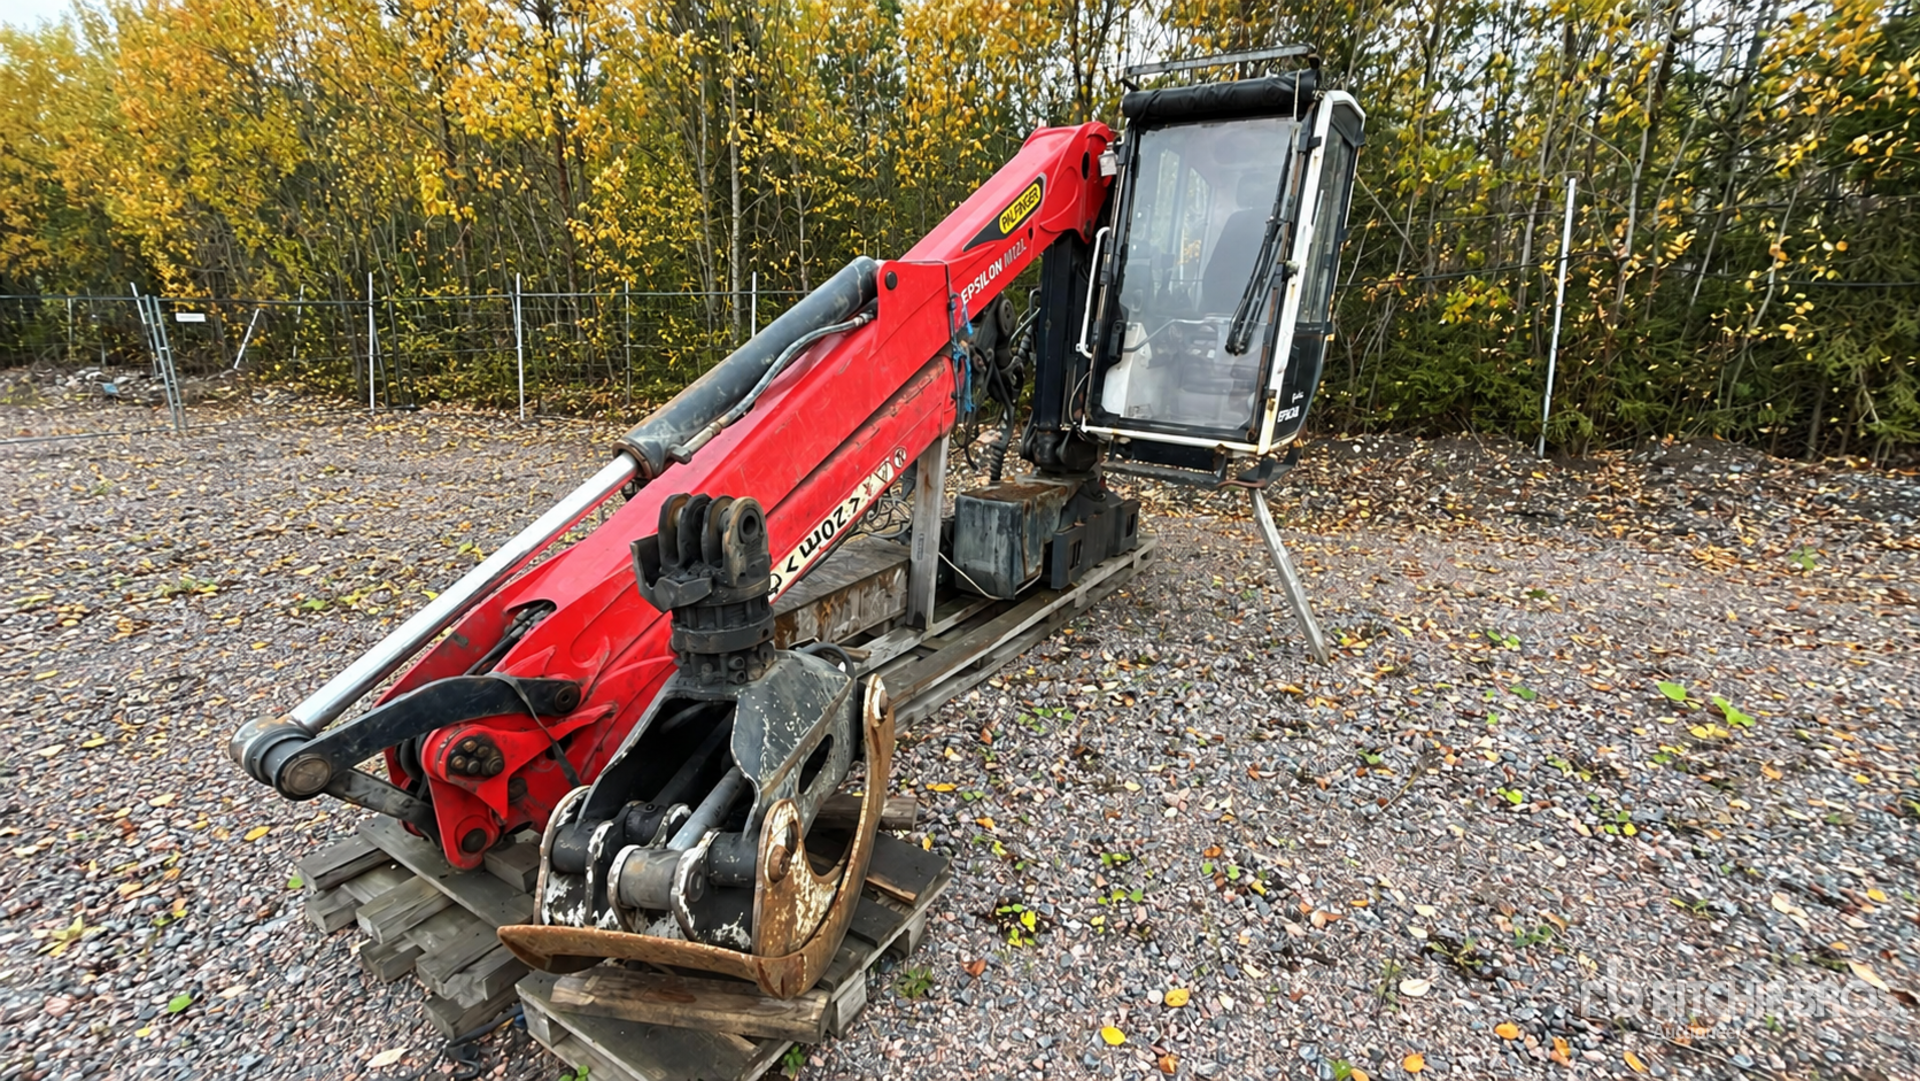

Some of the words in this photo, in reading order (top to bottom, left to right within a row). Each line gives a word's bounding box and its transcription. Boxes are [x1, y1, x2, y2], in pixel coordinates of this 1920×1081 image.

[1001, 187, 1039, 230] PALFINGER
[960, 258, 1003, 305] EPSILON
[799, 506, 847, 557] 20m
